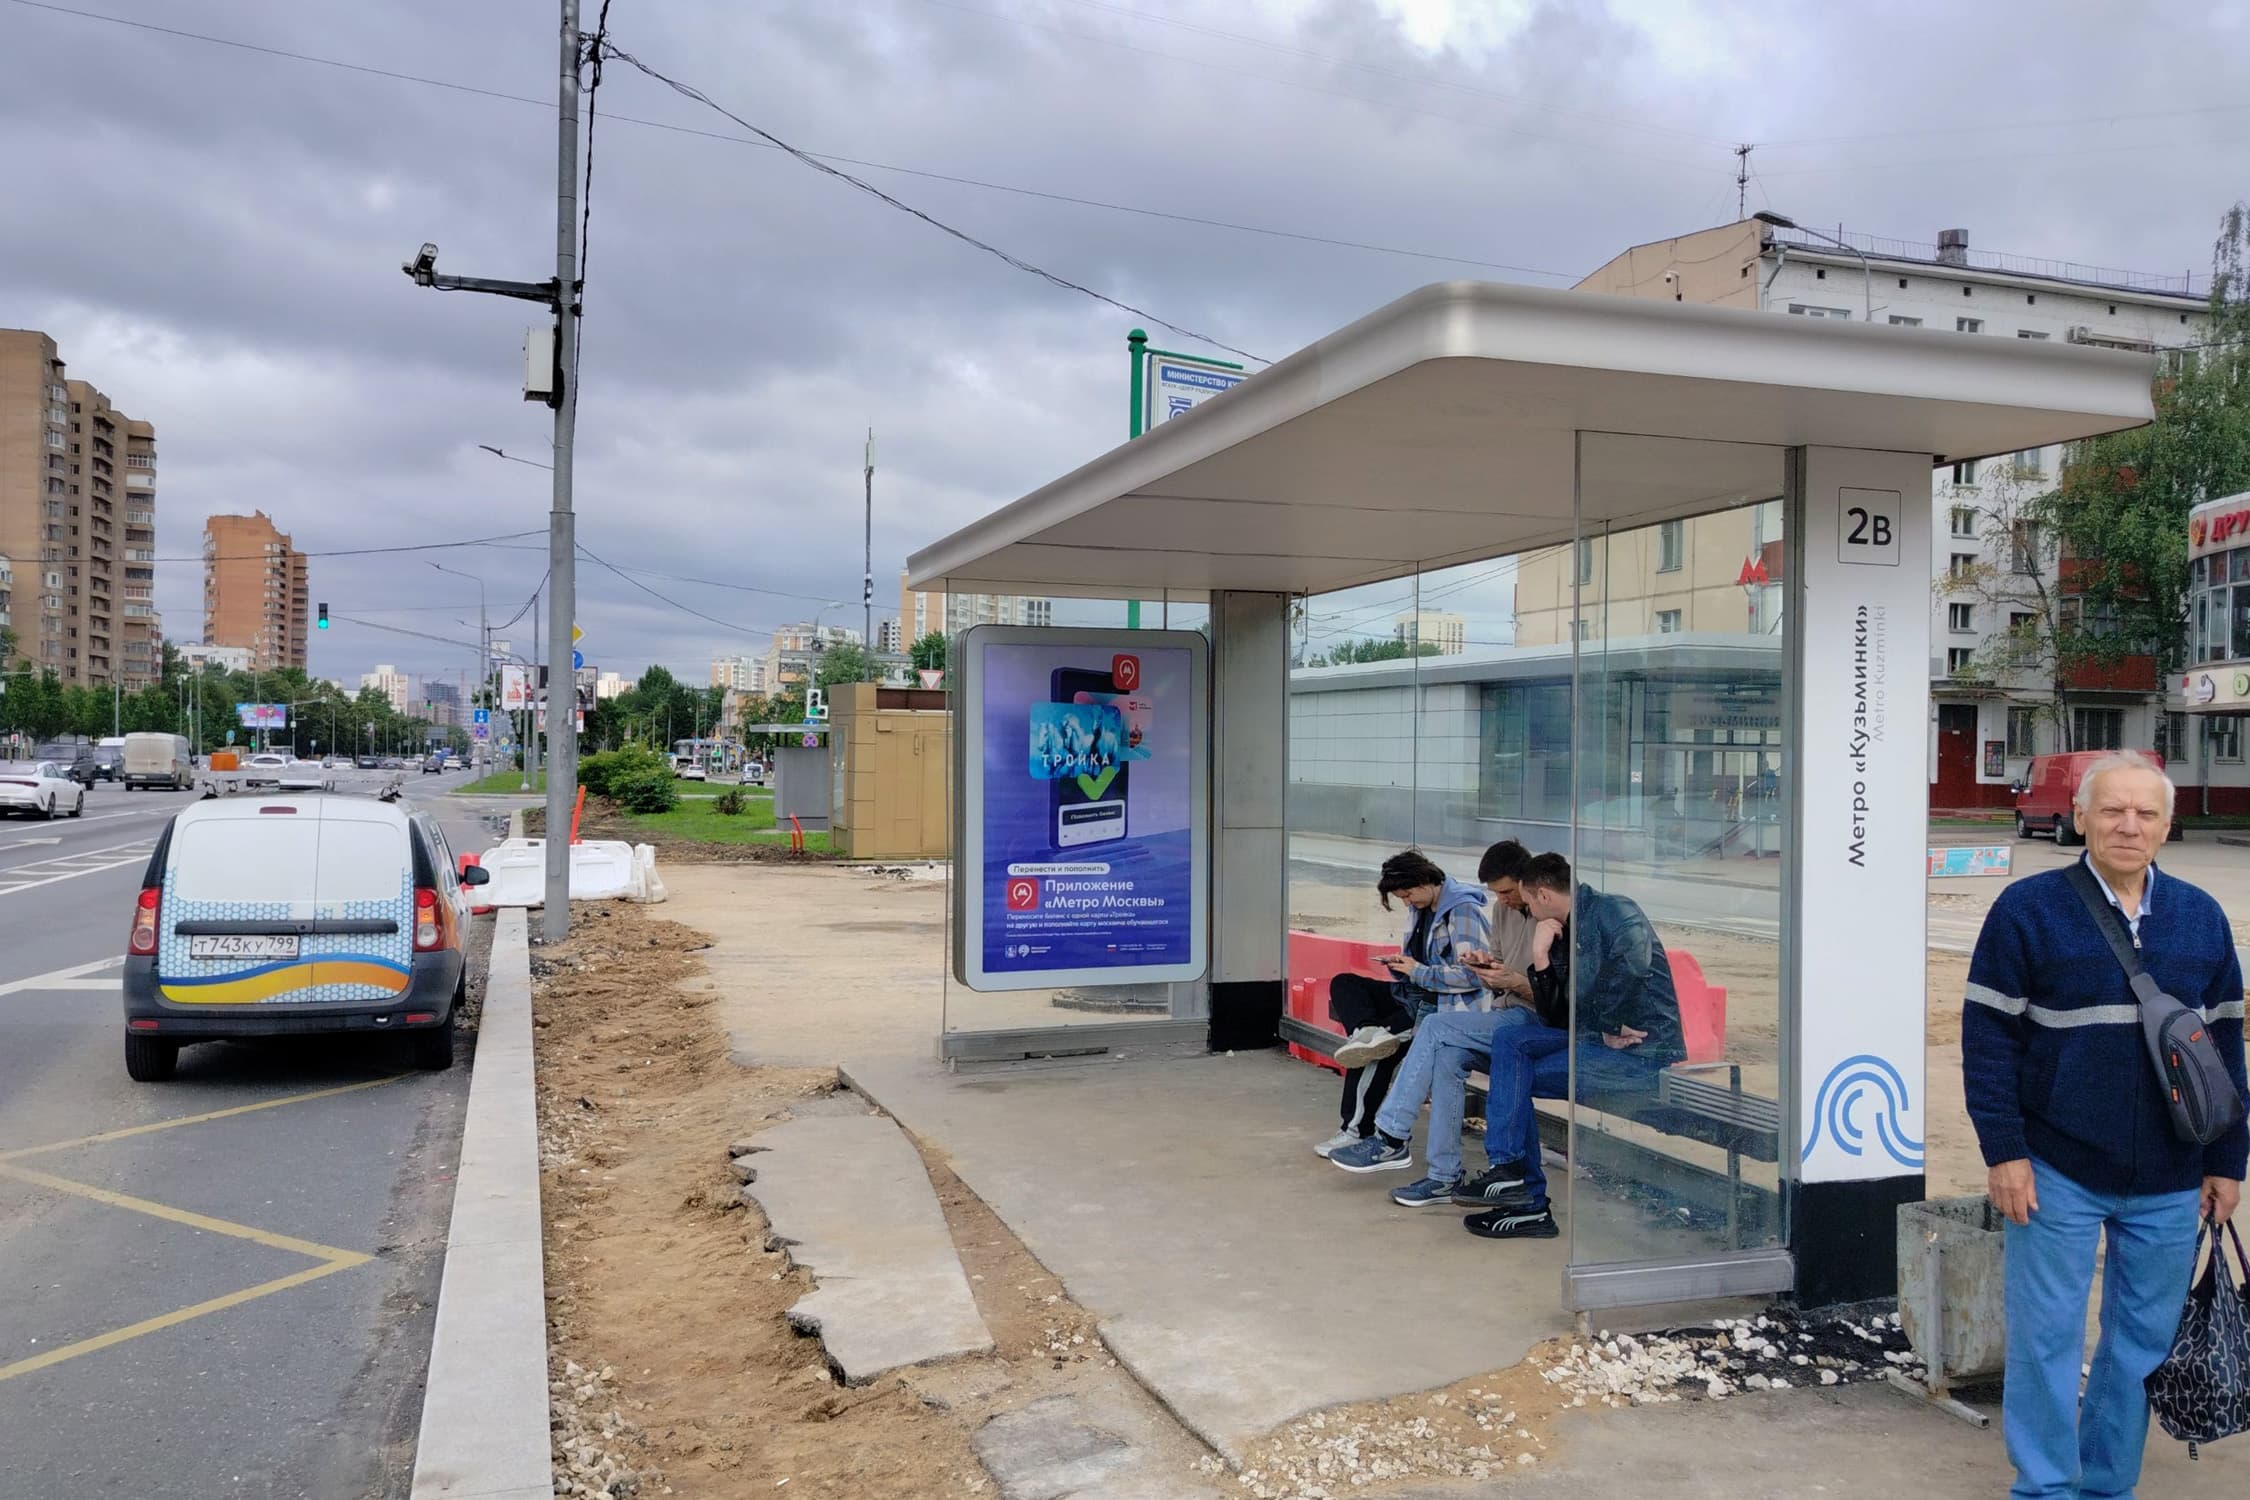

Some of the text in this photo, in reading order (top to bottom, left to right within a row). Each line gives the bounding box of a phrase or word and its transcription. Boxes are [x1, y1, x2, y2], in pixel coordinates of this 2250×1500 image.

[1167, 369, 1227, 388] МИНИСТЕРСТВО
[1873, 603, 1886, 742] Metro Kuzminki
[1848, 604, 1870, 868] Метро «Кузьминки»
[1041, 750, 1111, 768] ТРОЙКА
[1013, 865, 1056, 874] Перенести
[1045, 879, 1134, 894] Приложение
[1045, 895, 1165, 910] «Метро Москвы»
[198, 936, 295, 954] Т743КУ 799
